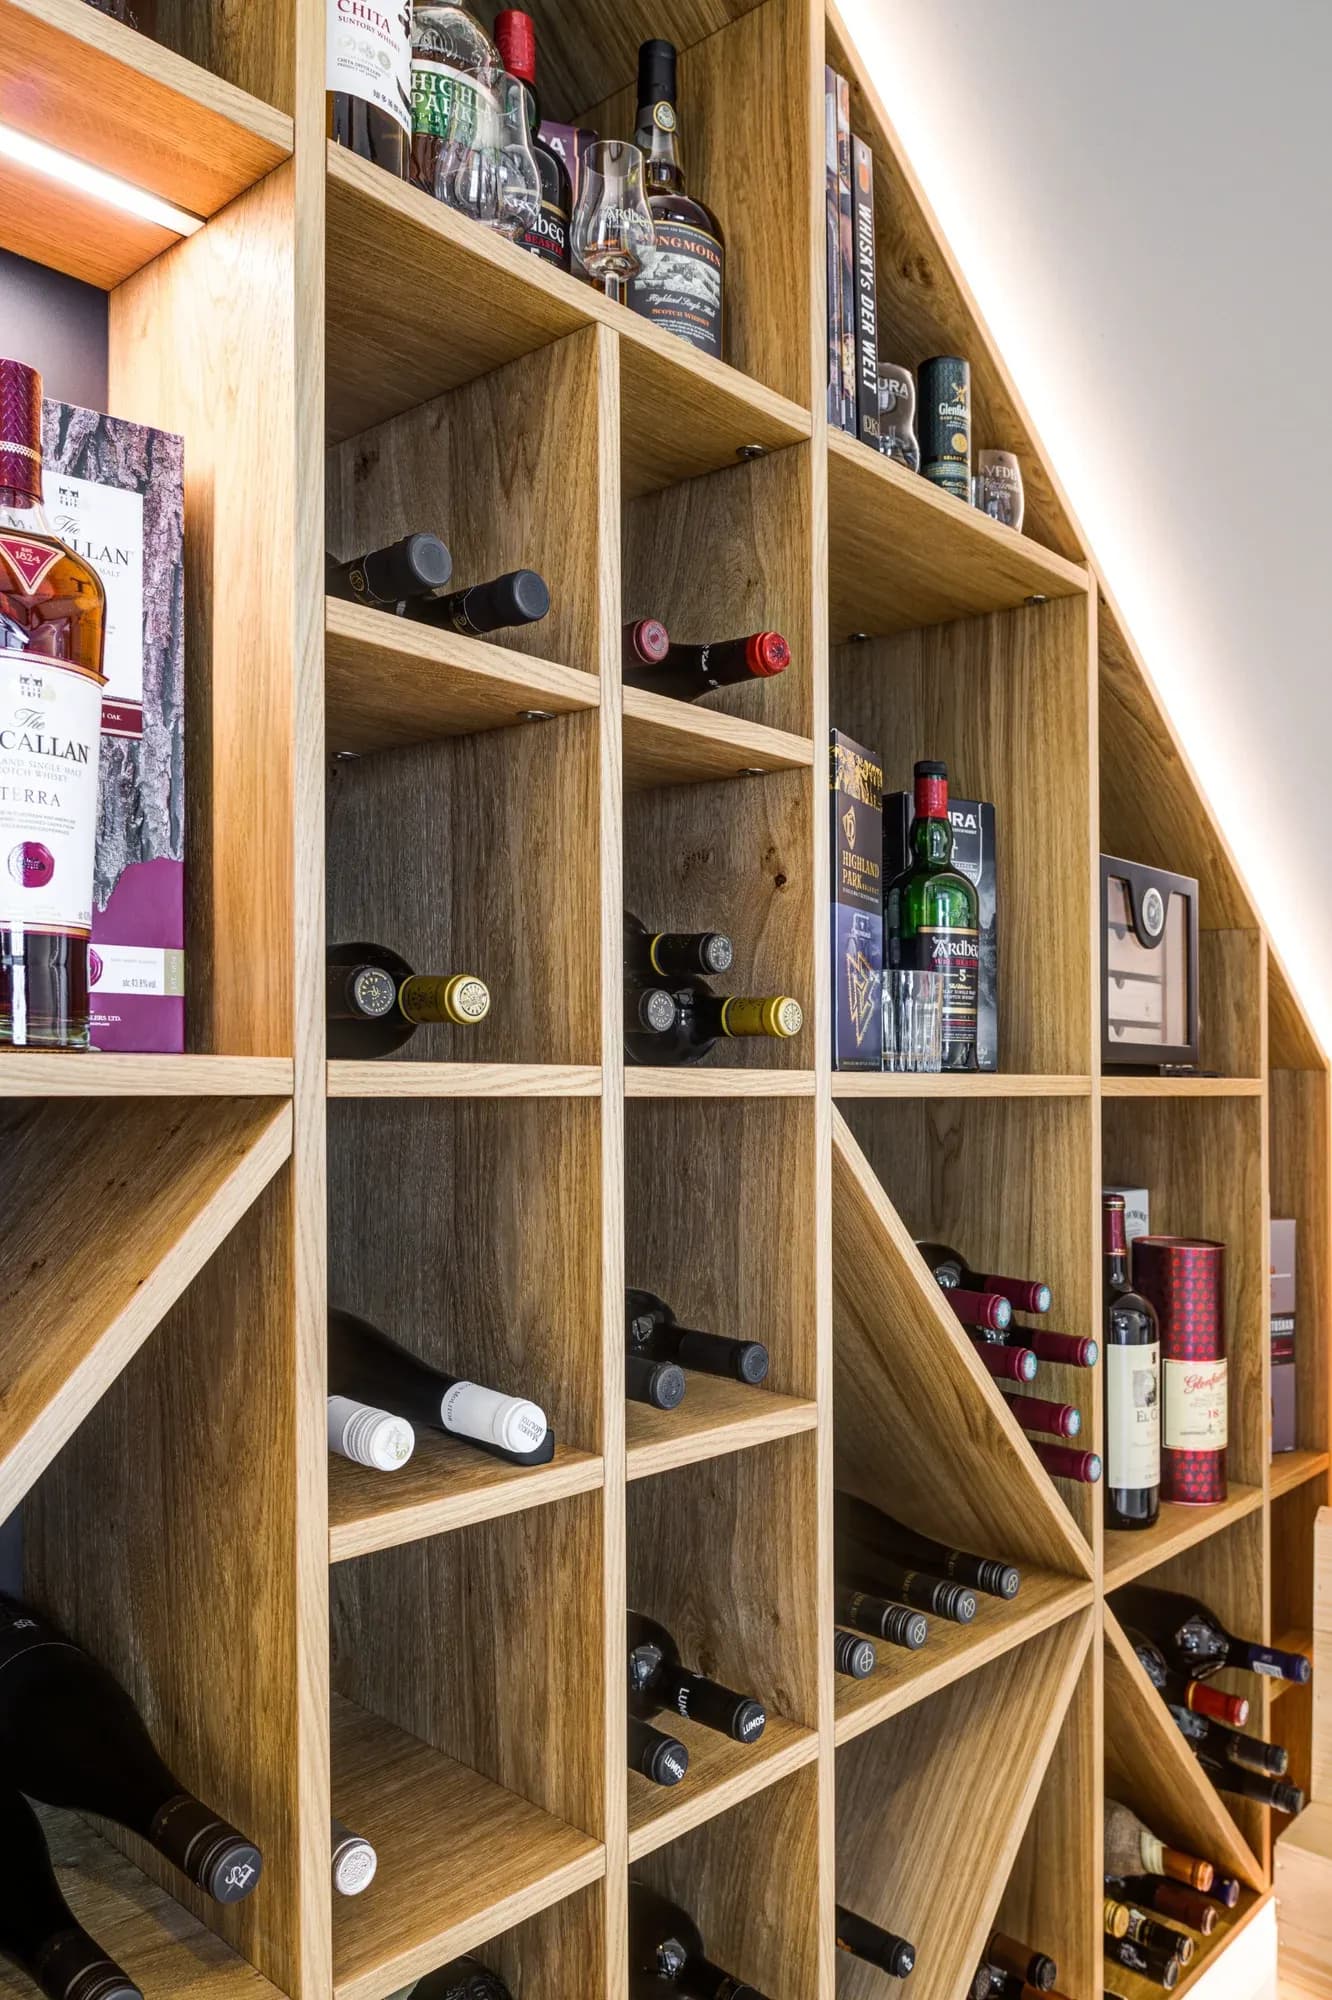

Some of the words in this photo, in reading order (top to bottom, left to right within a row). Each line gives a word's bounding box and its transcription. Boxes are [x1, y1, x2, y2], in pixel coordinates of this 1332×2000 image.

[337, 0, 391, 33] CHITA
[338, 15, 376, 33] SUNTORY
[377, 31, 400, 53] WHISKY
[655, 235, 720, 267] NGMORN
[861, 299, 875, 335] DER
[862, 340, 877, 394] WELT
[878, 377, 909, 397] URA
[54, 515, 80, 534] The
[15, 550, 41, 564] 1824
[64, 538, 129, 566] LLAN
[13, 708, 46, 729] The
[0, 730, 90, 764] CALLAN
[0, 766, 31, 777] OTCH
[0, 786, 61, 807] TERRA
[842, 850, 880, 878] HIGHLAND
[842, 868, 862, 890] PARK
[959, 969, 967, 982] 5
[1207, 1409, 1219, 1419] 18
[677, 1687, 690, 1719] LUMO
[742, 1714, 765, 1736] LUMOS
[664, 1754, 685, 1779] LUMOS
